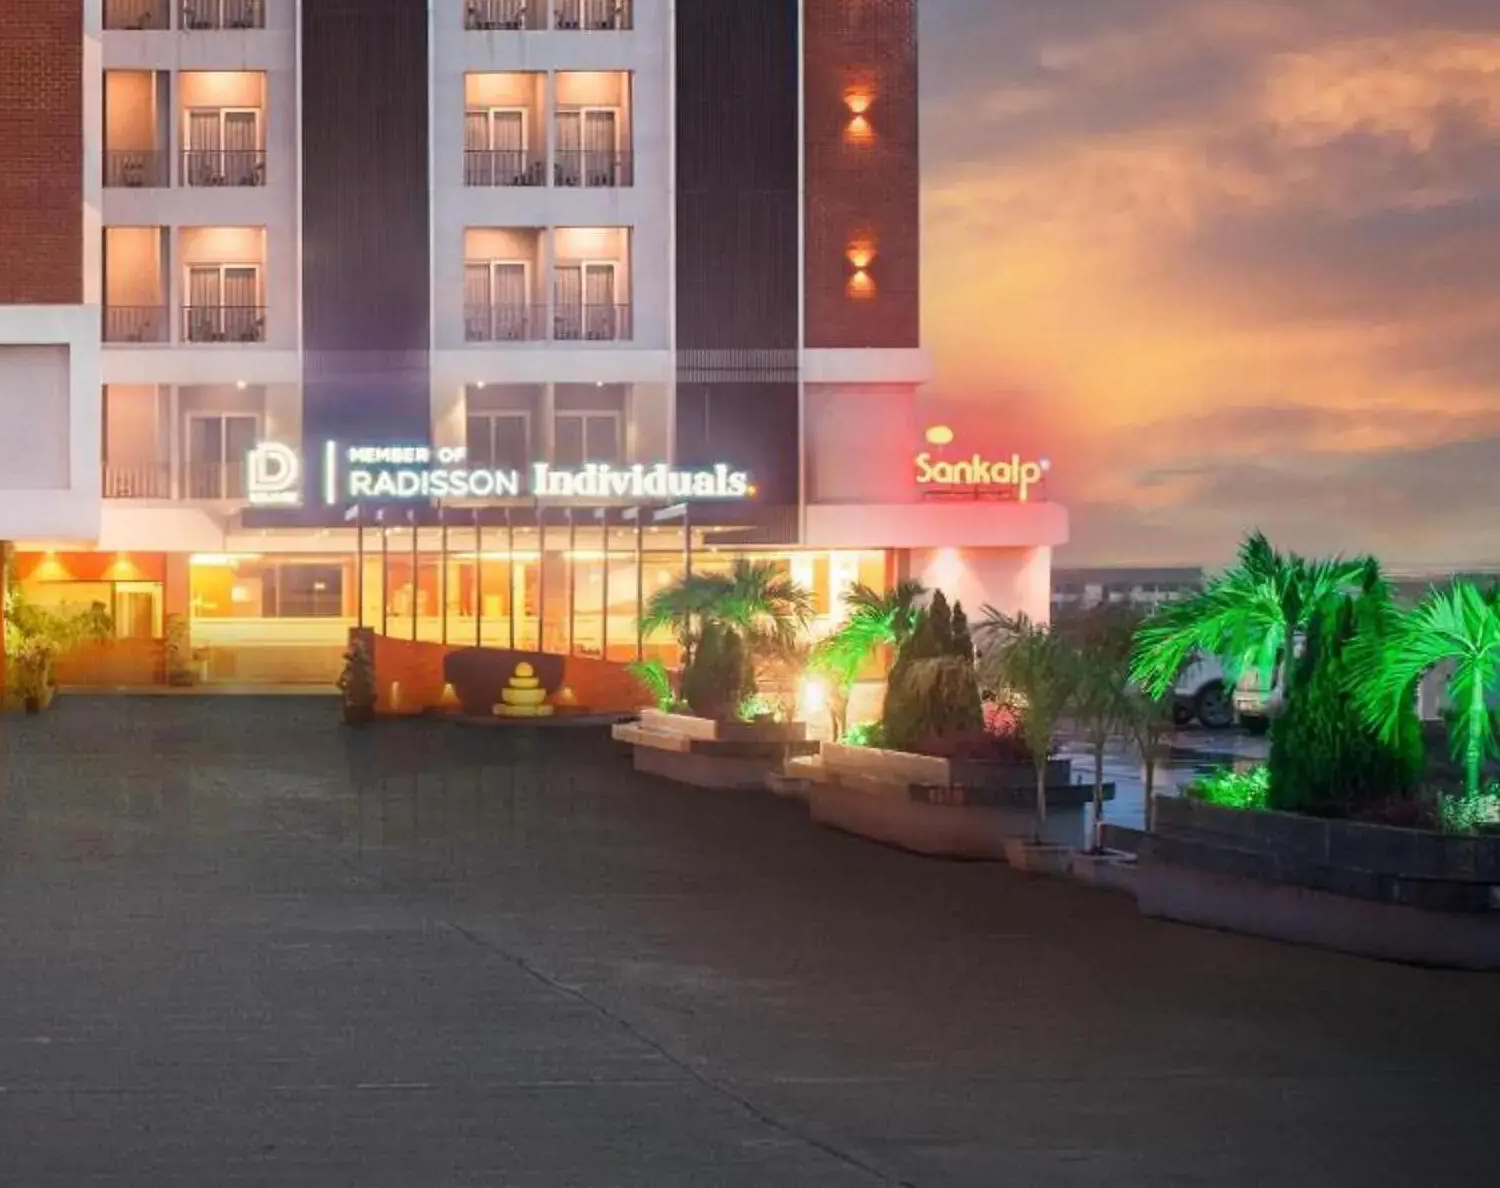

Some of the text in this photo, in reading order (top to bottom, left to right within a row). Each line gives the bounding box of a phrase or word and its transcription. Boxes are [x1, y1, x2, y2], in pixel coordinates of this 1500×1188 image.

[348, 447, 467, 463] MEMBER OF
[350, 470, 518, 496] RADISSON
[915, 452, 1041, 502] Sankalp
